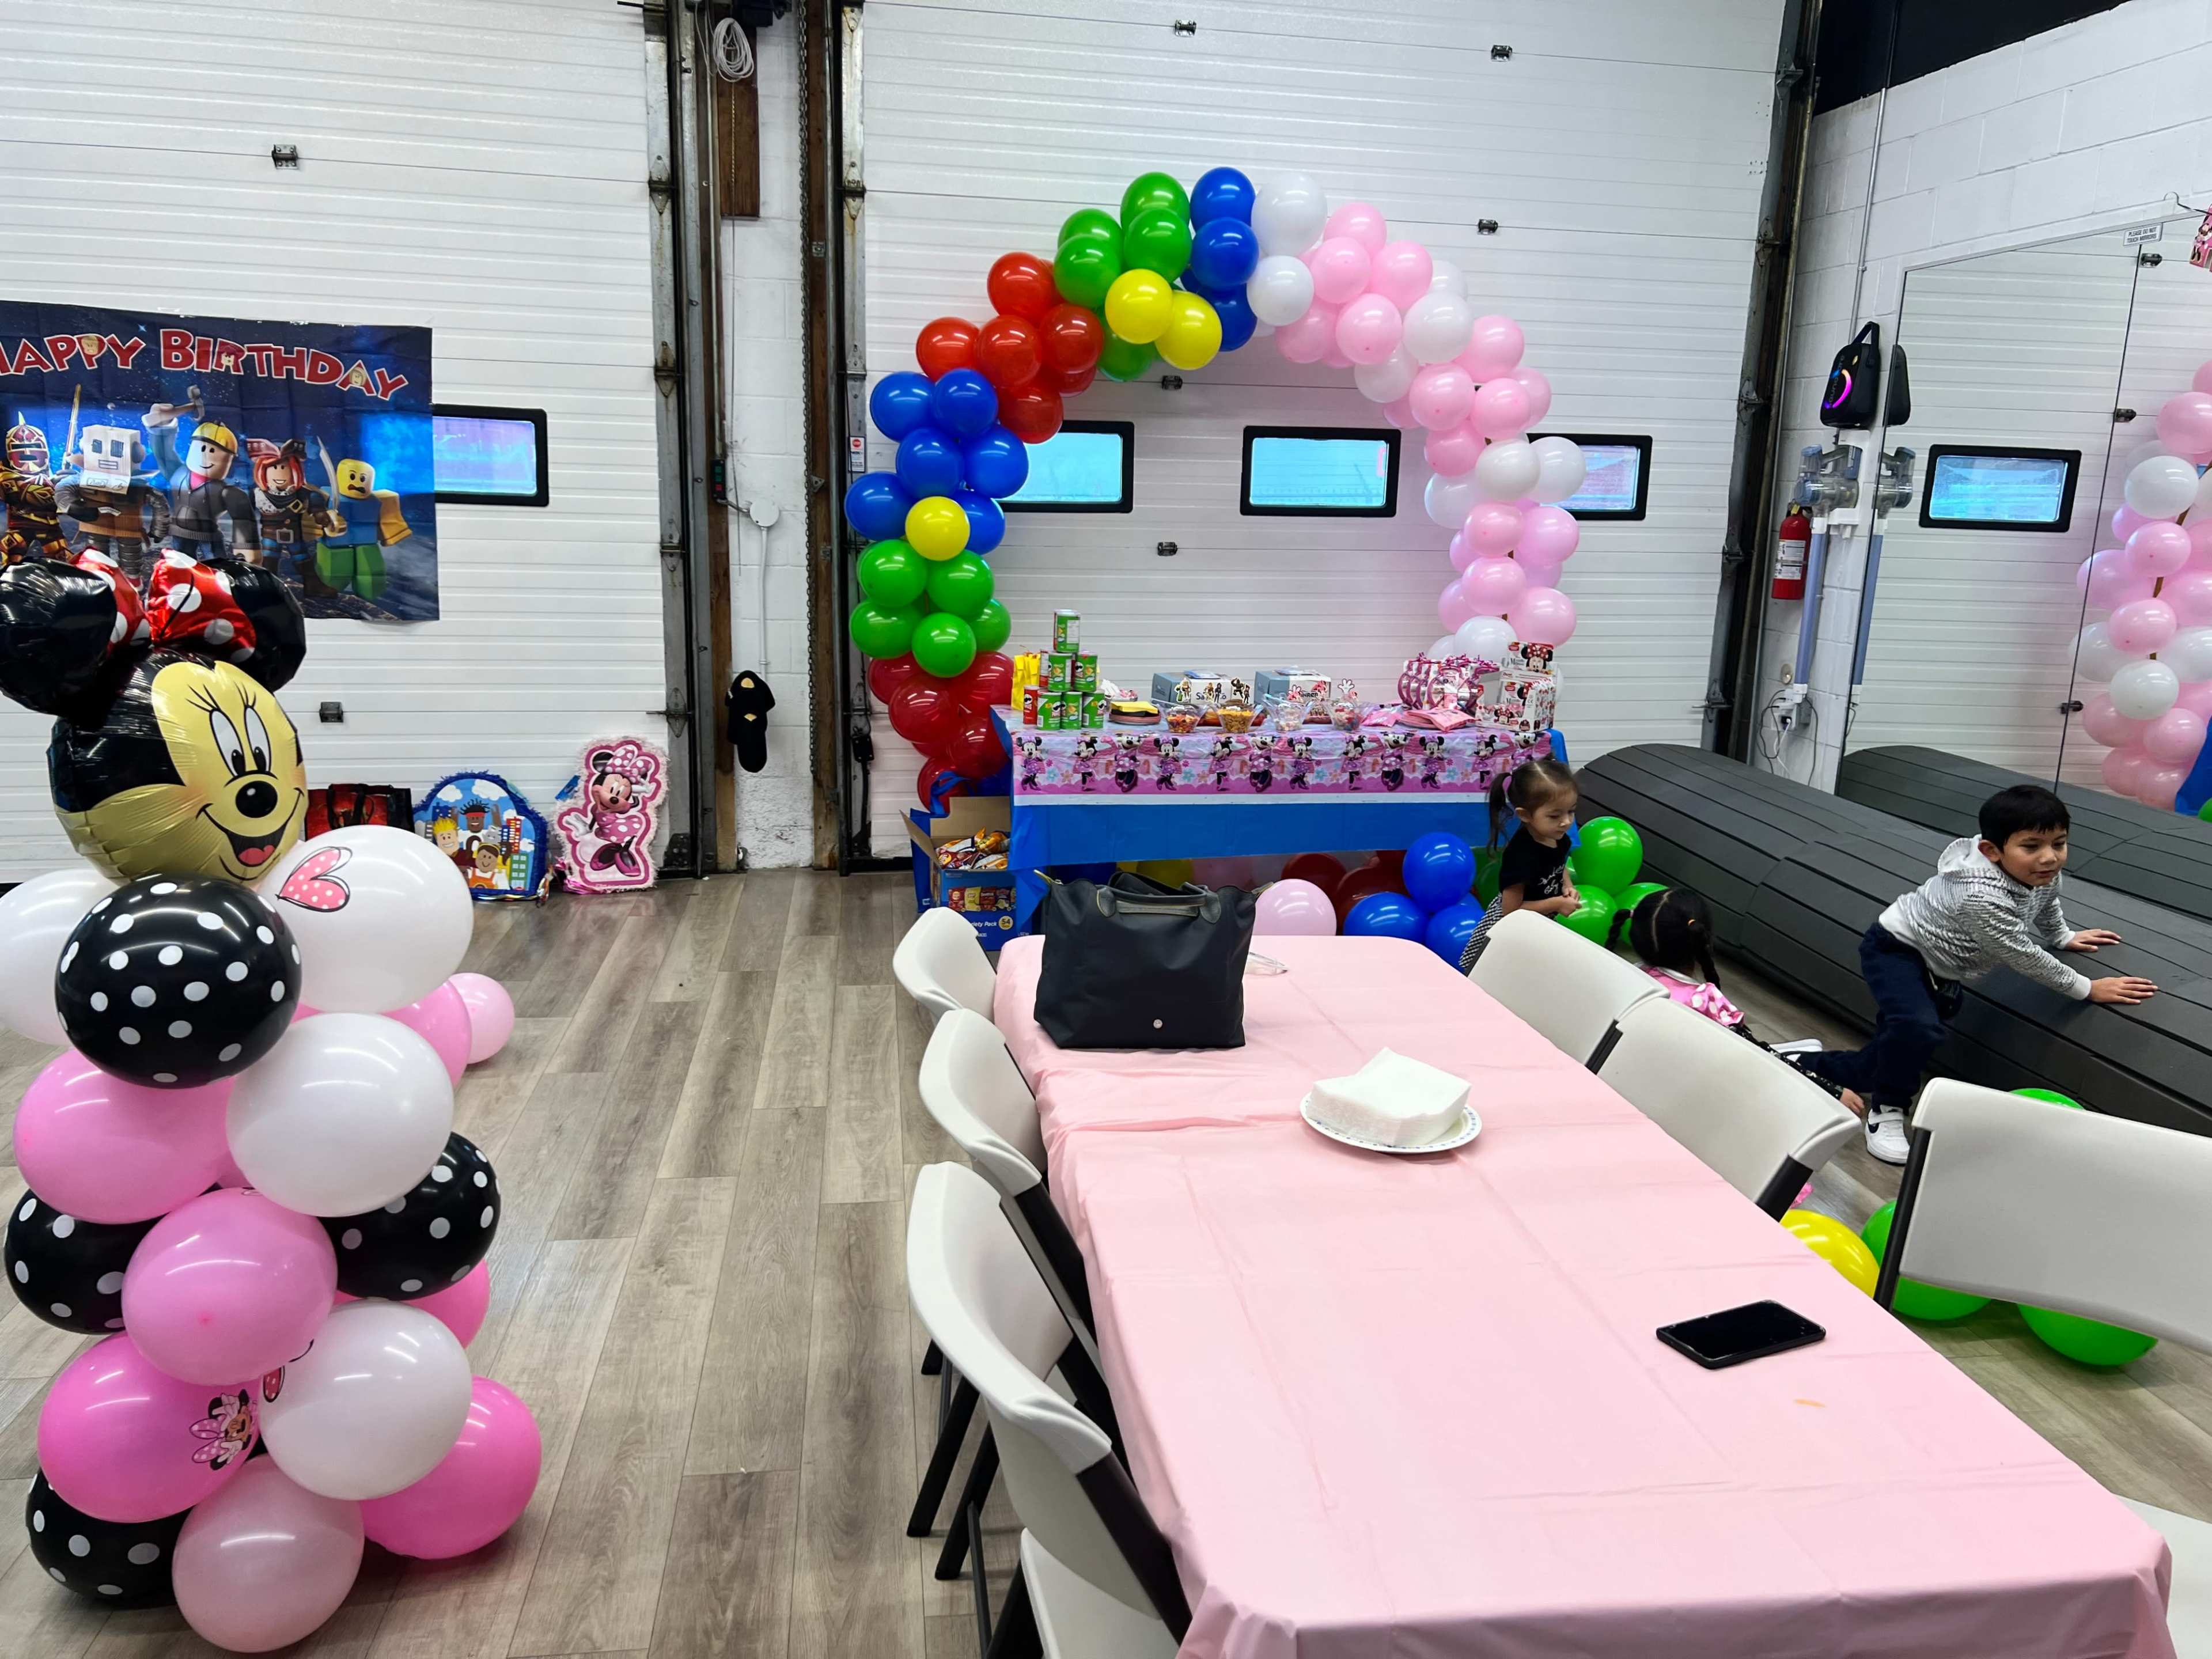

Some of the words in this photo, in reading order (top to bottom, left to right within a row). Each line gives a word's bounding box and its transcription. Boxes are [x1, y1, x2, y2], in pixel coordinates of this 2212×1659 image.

[2139, 233, 2157, 241] MIRRORS
[0, 334, 146, 375] APPY
[160, 328, 408, 400] BIRTHDAY
